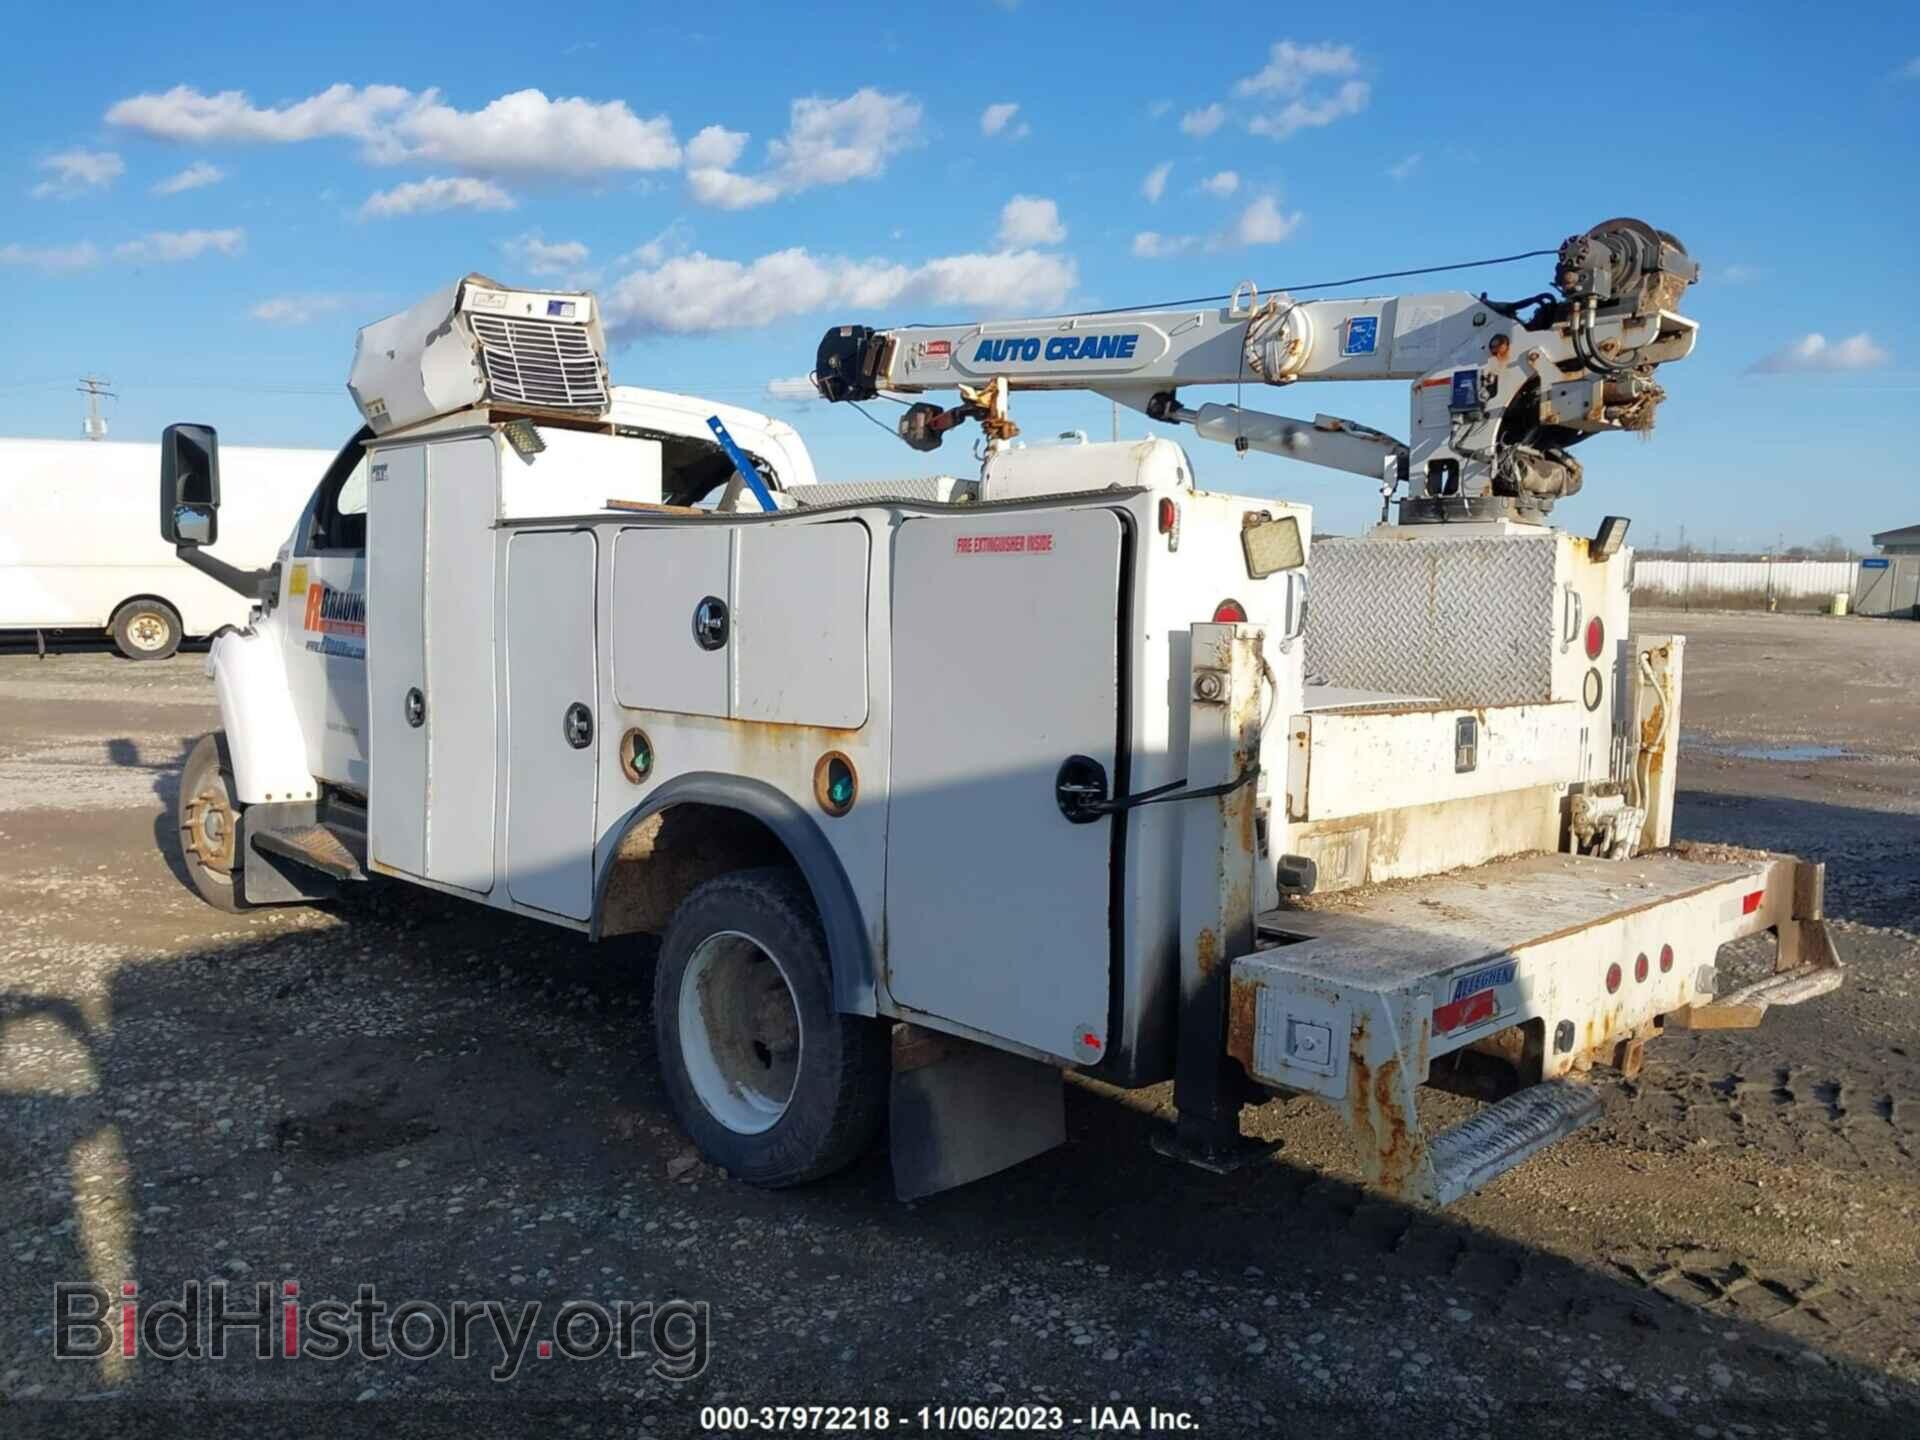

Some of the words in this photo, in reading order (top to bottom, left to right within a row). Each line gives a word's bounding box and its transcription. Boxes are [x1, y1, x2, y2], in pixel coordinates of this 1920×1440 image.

[974, 338, 1040, 362] AUTO
[1044, 334, 1139, 360] CRANE
[956, 537, 973, 552] FIRE
[974, 535, 1025, 552] EXTINGUISHER
[1027, 533, 1053, 551] INSIDE
